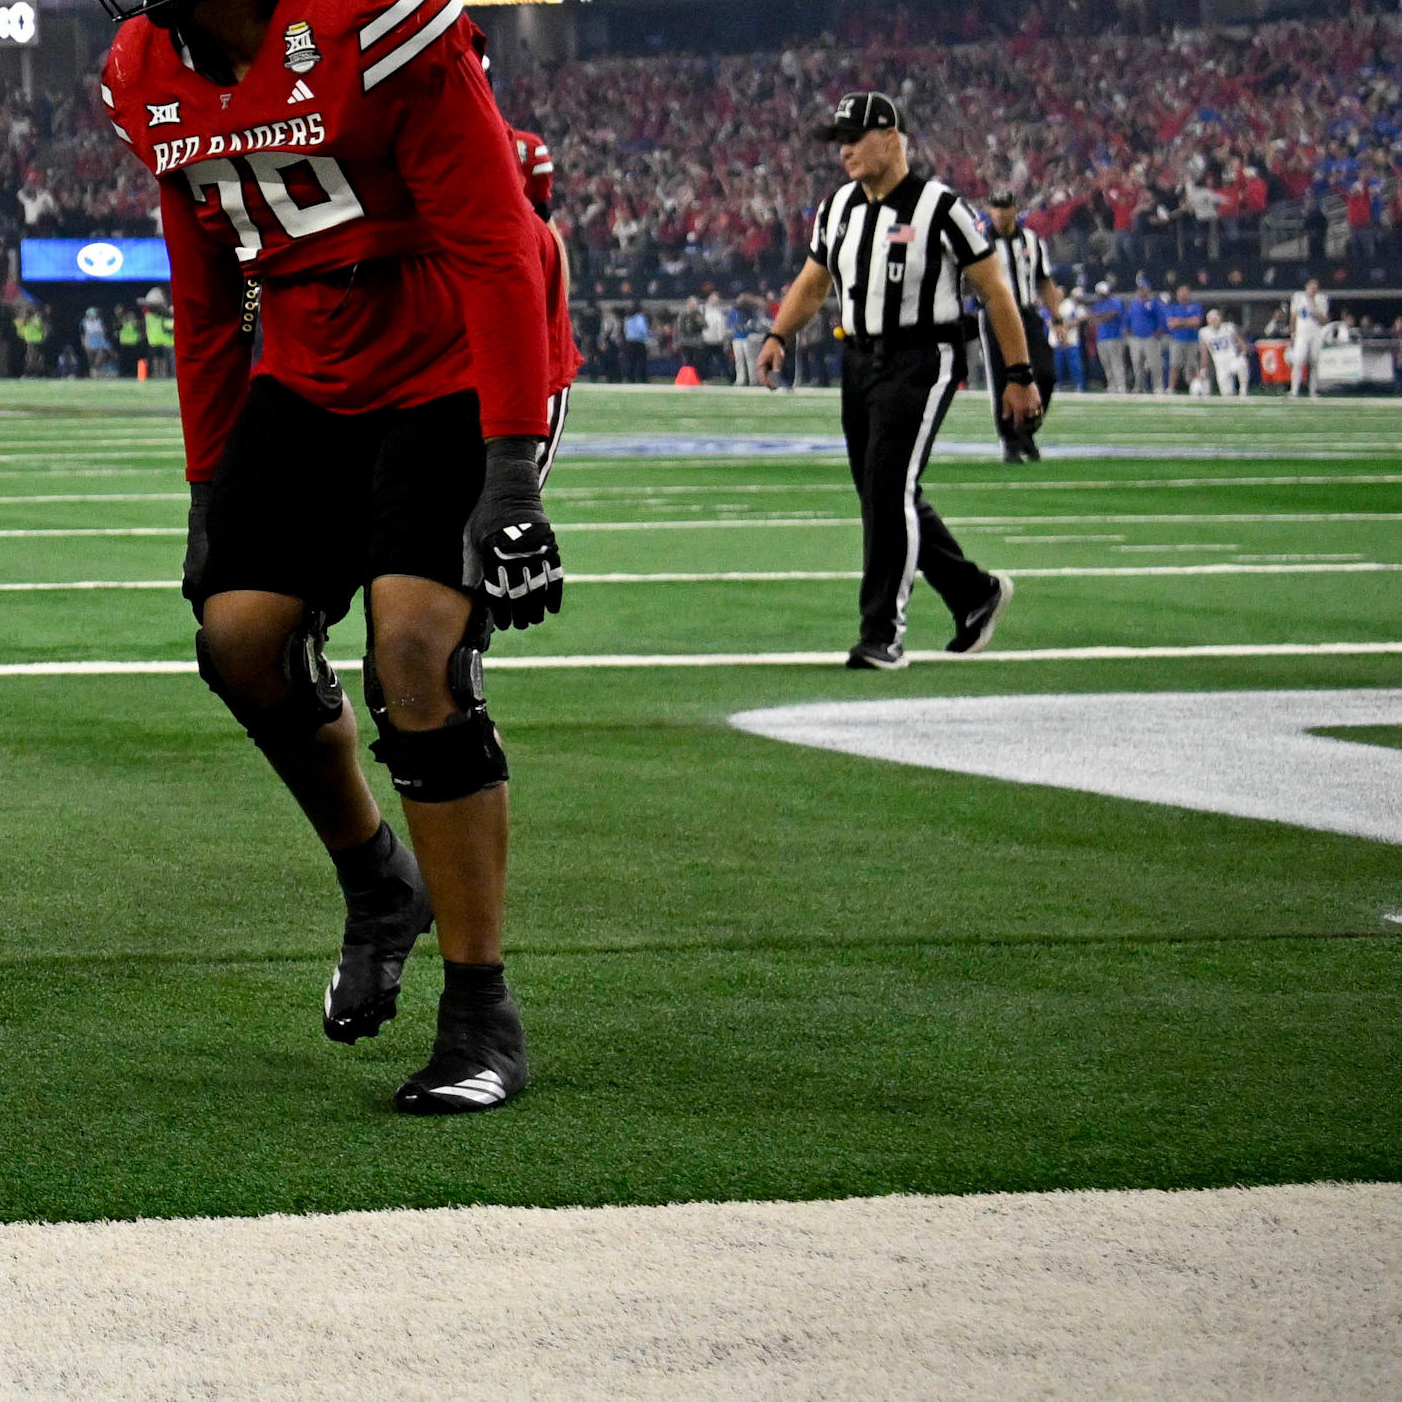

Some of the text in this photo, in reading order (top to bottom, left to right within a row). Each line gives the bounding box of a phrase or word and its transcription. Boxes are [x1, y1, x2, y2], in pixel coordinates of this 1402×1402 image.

[146, 101, 181, 127] XII
[153, 112, 326, 176] RED RAIDERS
[888, 262, 904, 283] U
